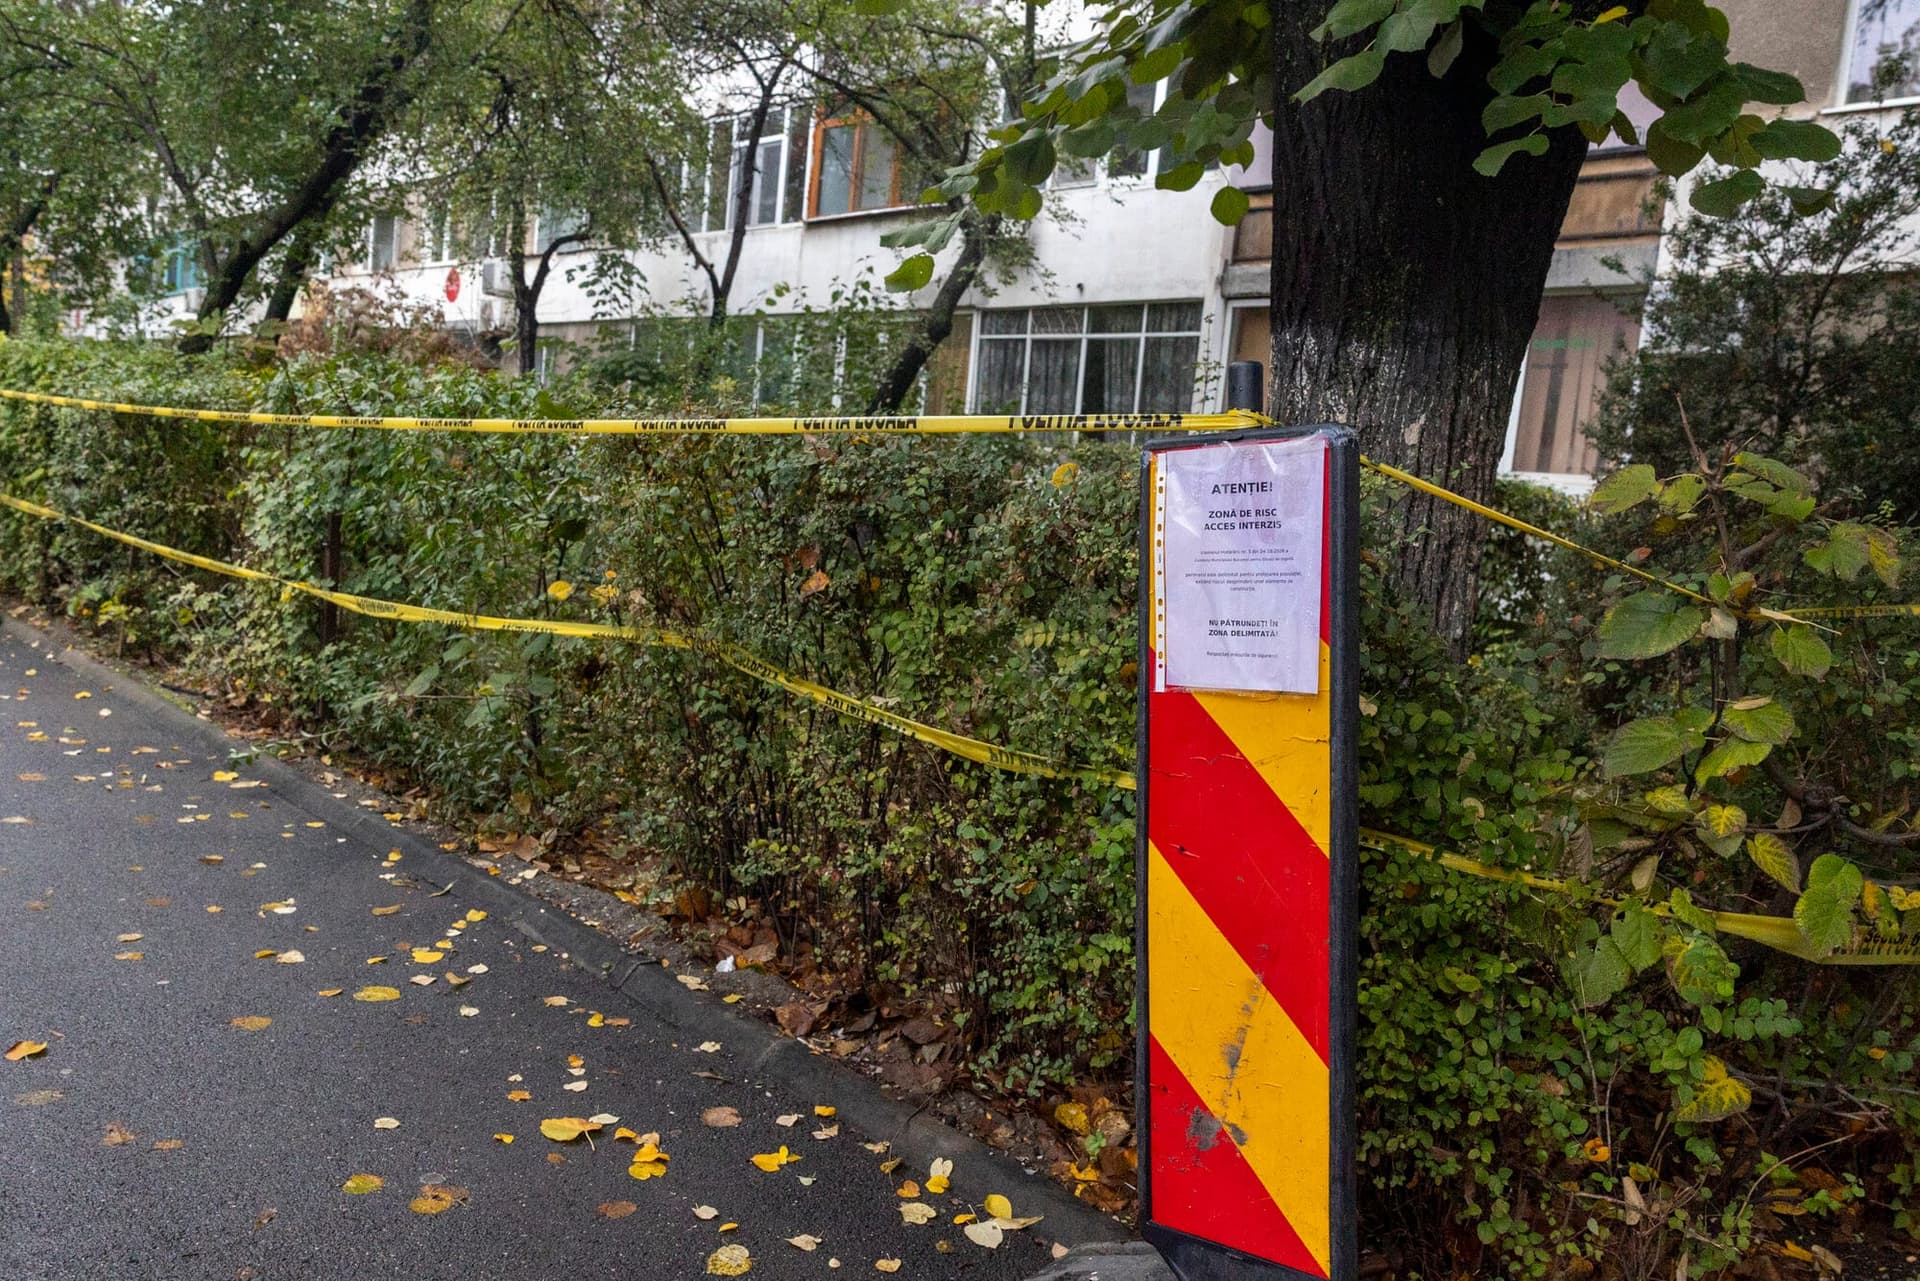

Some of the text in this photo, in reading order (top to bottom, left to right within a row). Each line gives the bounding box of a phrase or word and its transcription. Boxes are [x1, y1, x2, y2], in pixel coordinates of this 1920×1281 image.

[1211, 481, 1273, 496] ATENȚIE!
[1239, 510, 1252, 518] DE
[1255, 508, 1277, 518] RISC
[1204, 520, 1282, 531] ACCES INTERZIS
[1208, 629, 1229, 637] ZONA
